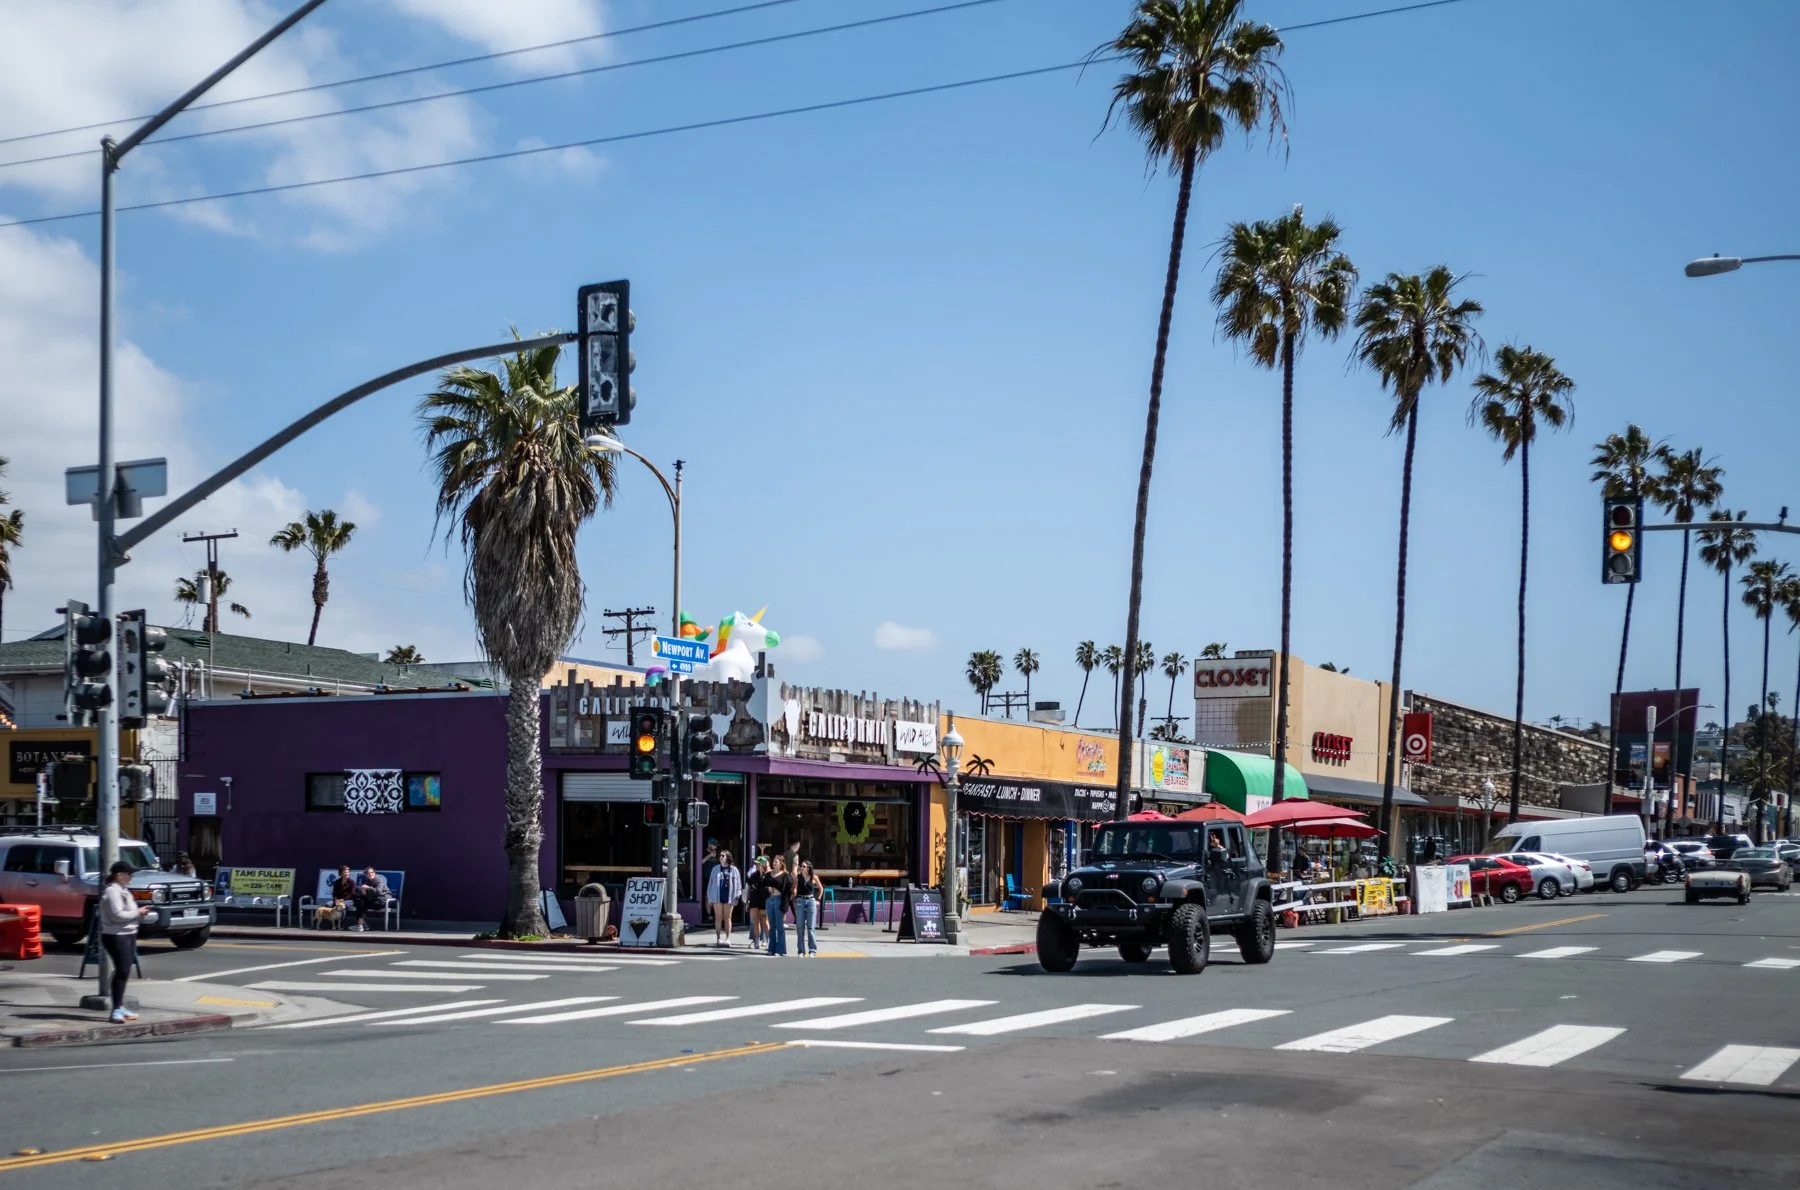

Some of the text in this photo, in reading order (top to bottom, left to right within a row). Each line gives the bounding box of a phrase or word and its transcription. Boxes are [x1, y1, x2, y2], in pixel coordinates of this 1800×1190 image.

[1195, 668, 1270, 688] CLOSET
[996, 786, 1018, 800] LUNCH
[1020, 788, 1041, 802] DINNER
[258, 870, 291, 878] FULLER
[628, 880, 663, 892] PLANT
[629, 893, 657, 905] SHOP
